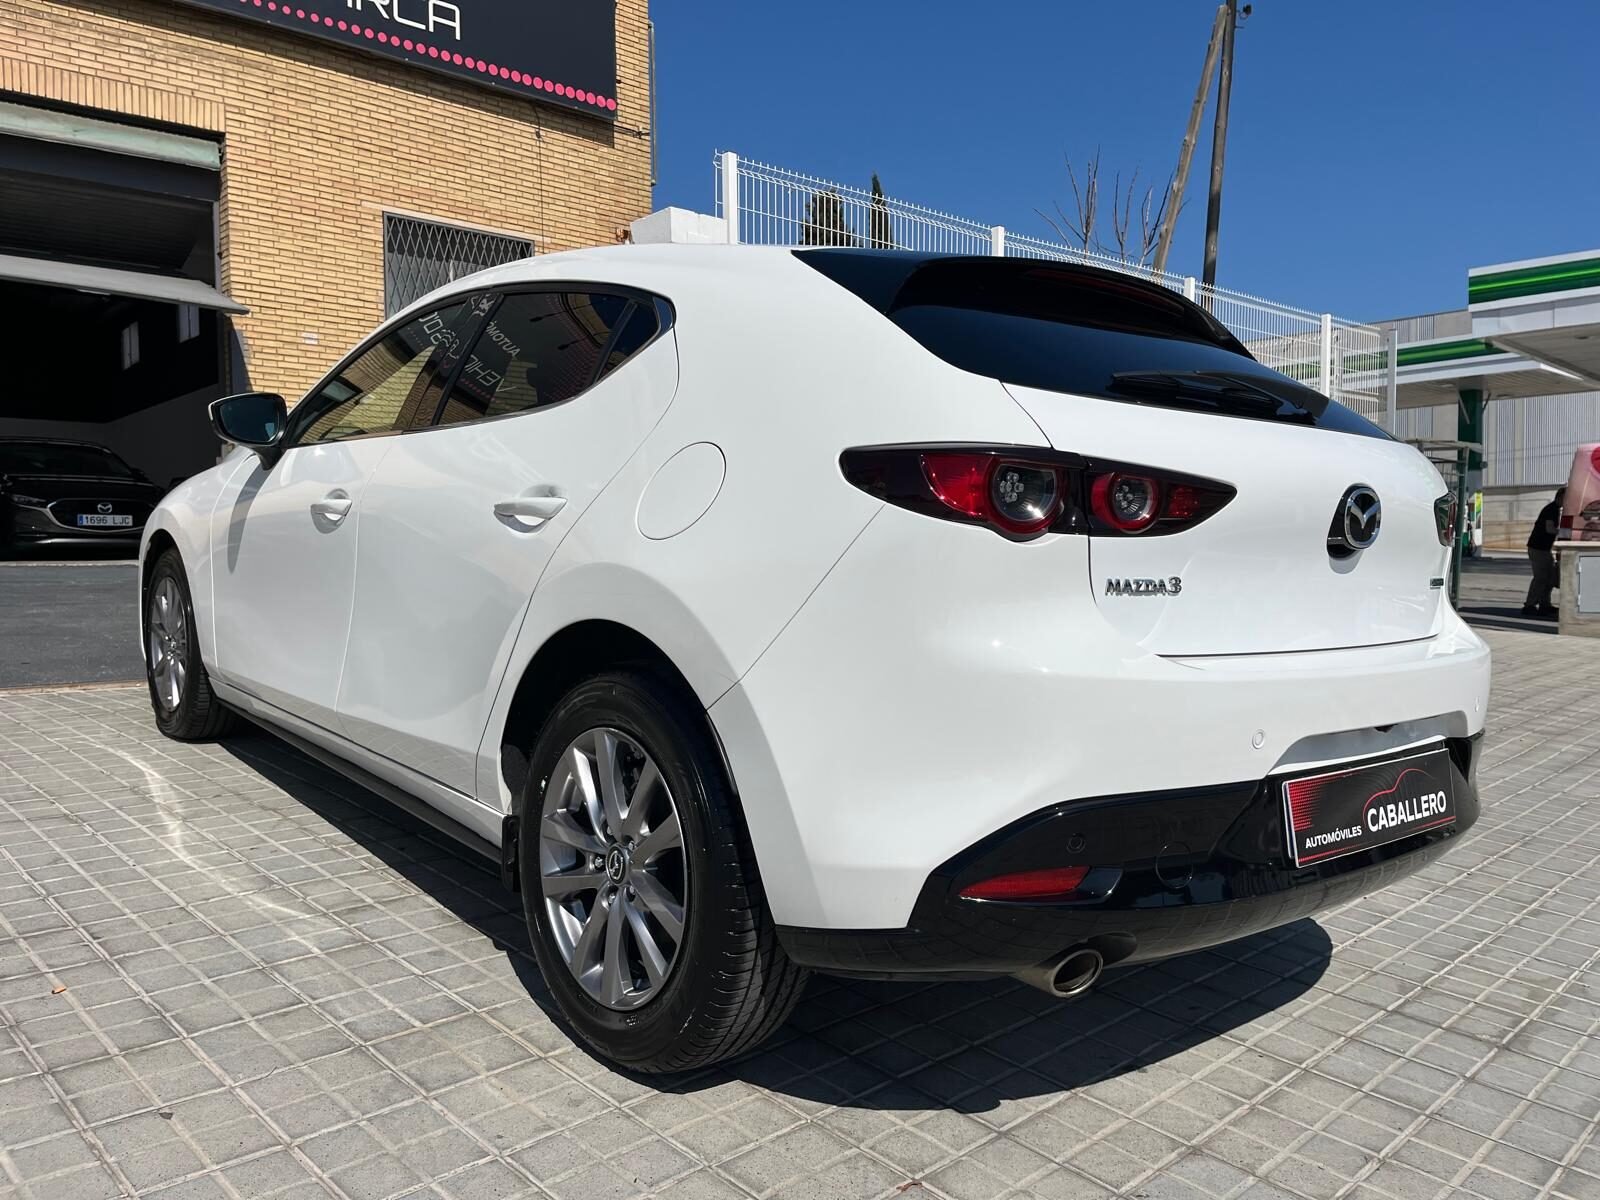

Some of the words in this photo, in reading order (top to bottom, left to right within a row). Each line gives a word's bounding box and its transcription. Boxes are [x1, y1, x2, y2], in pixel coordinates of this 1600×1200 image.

[346, 0, 461, 41] RCA
[86, 516, 108, 525] 1696
[1104, 576, 1182, 596] MAZDA3
[1305, 825, 1363, 849] AUTOMÓVILES
[1366, 790, 1448, 832] CABALLERO
